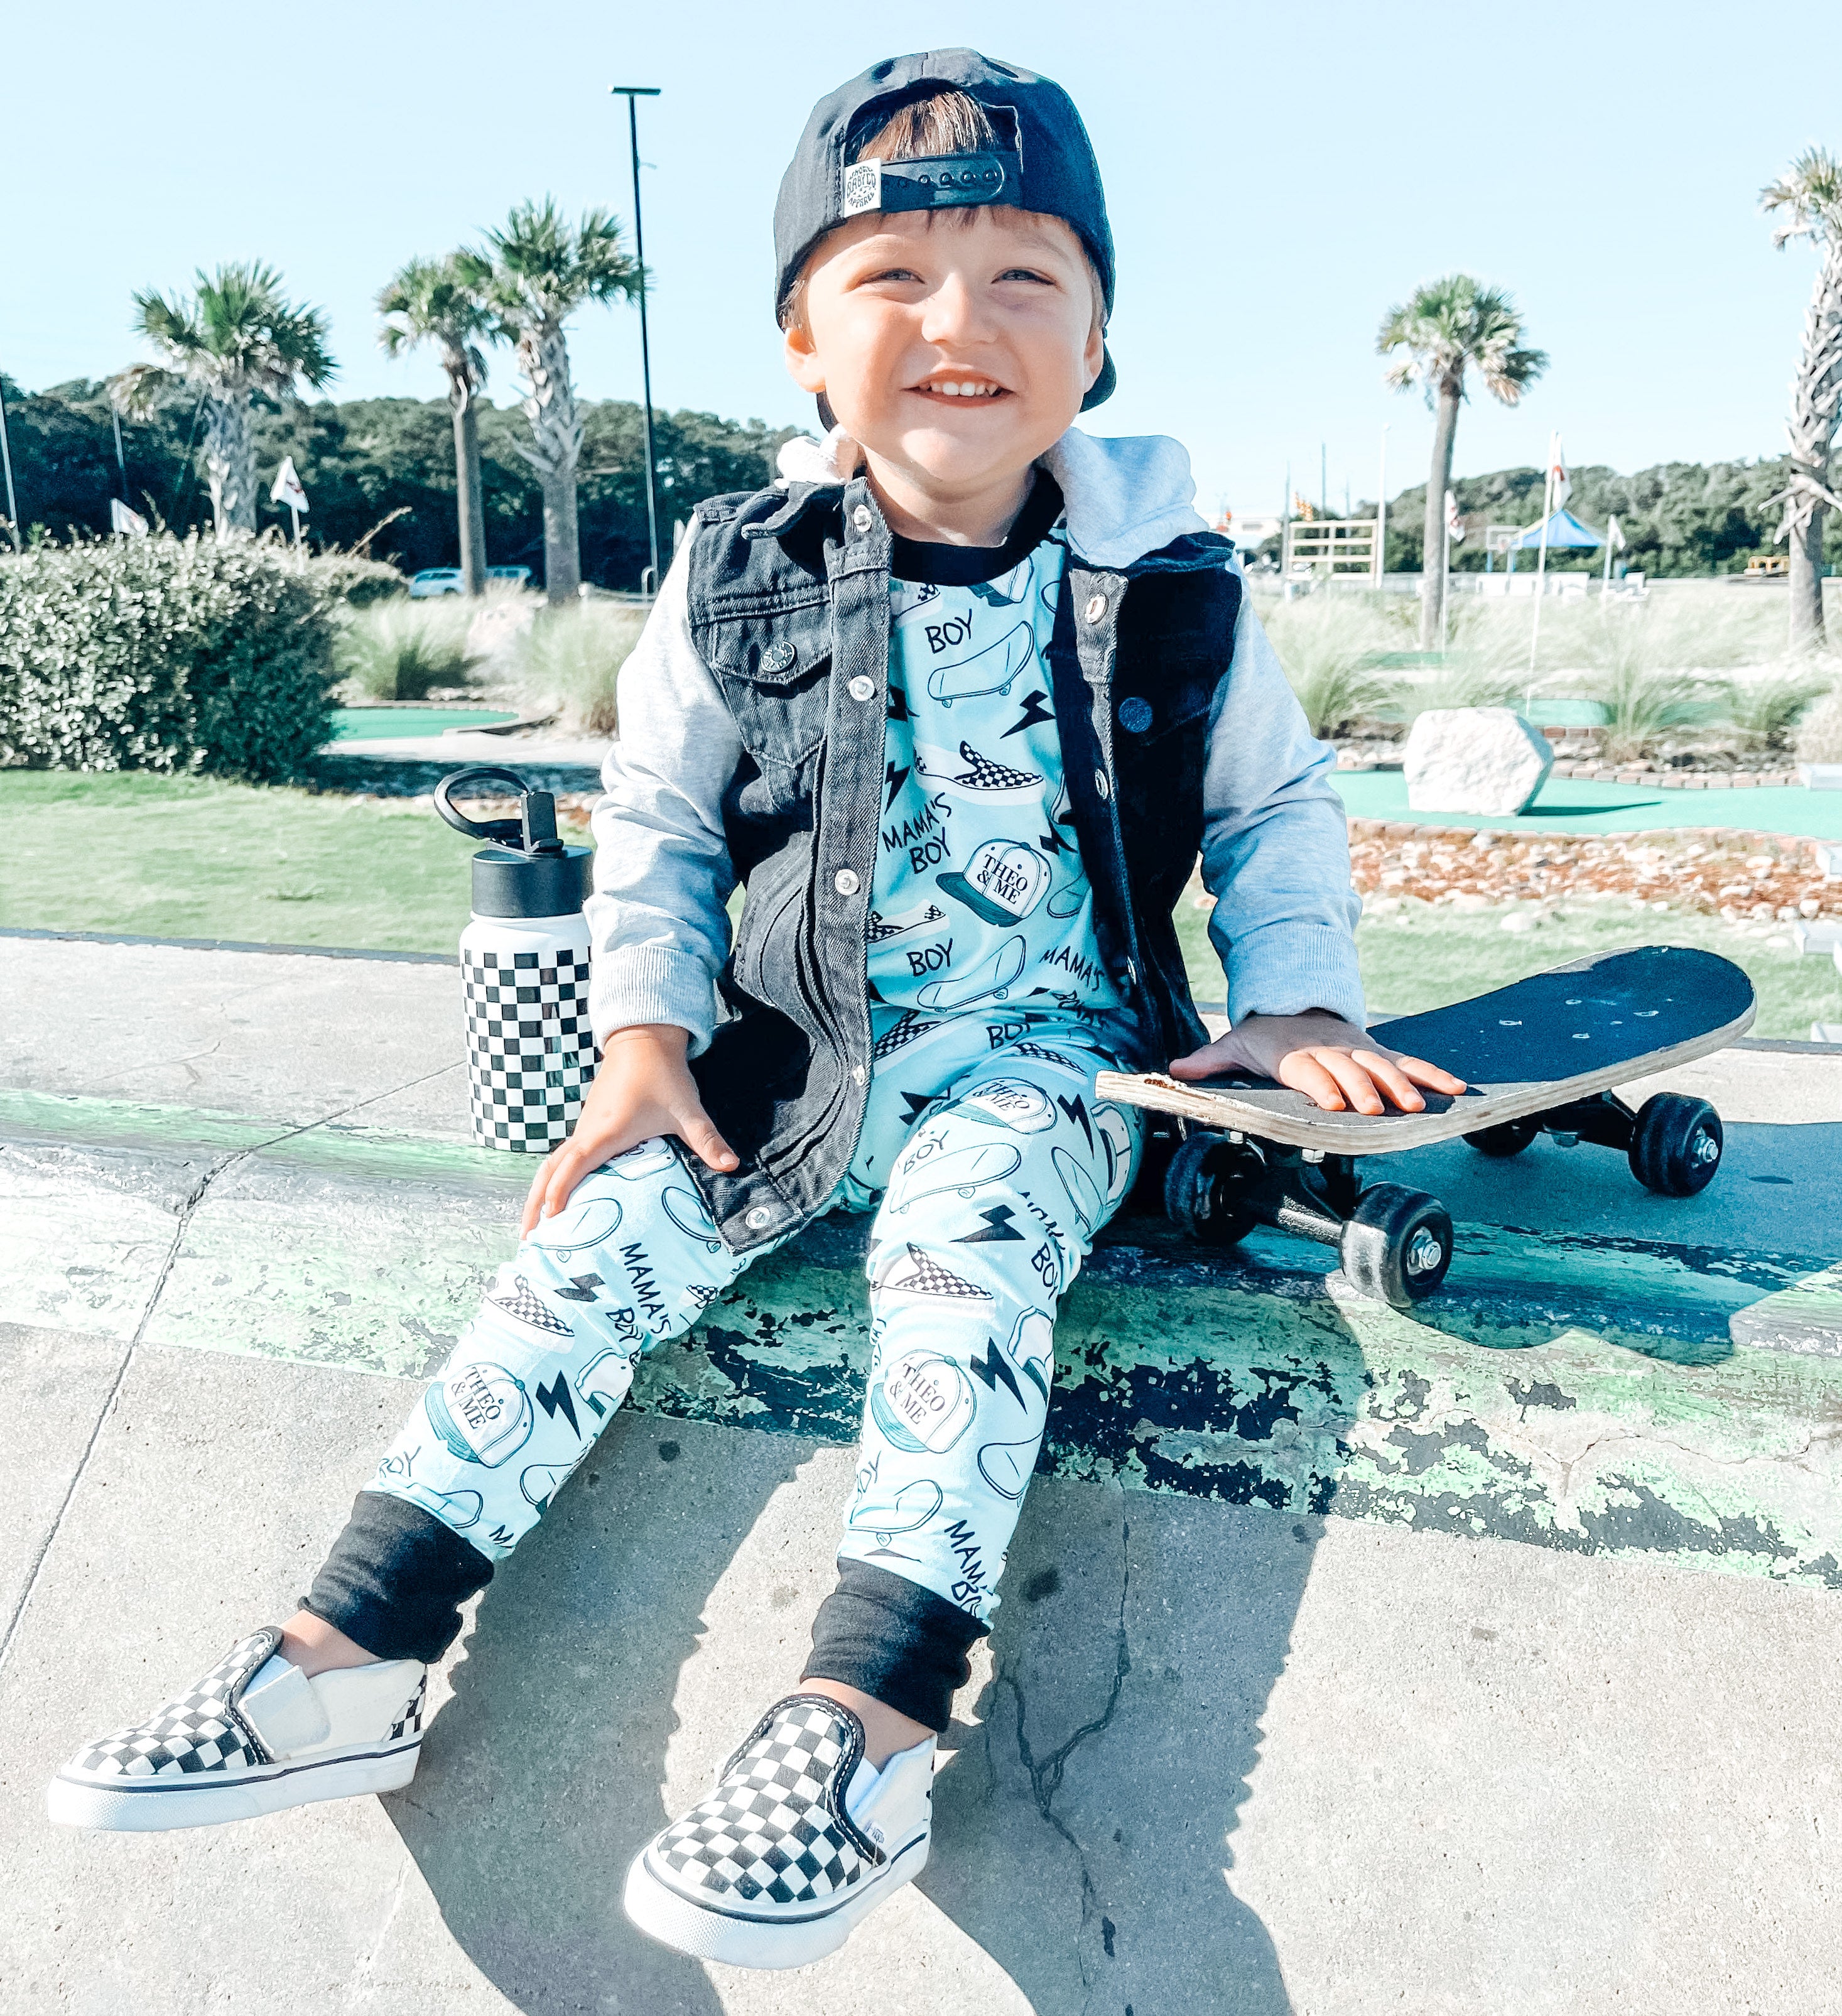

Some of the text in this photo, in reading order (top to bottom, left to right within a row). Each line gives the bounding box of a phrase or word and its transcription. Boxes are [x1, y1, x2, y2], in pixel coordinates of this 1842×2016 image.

[925, 609, 972, 654] BOY
[882, 792, 952, 852] MAMA'S
[911, 826, 951, 874] BOY
[977, 870, 1021, 905] & ME
[984, 854, 1028, 892] THEO
[906, 938, 953, 977] BOY
[1039, 945, 1105, 991] MAMA'S
[986, 1093, 1016, 1111] ME
[987, 1081, 1030, 1109] THEO
[904, 1130, 950, 1175] BOY
[619, 1243, 672, 1334] MAMA'S
[451, 1382, 487, 1429] & ME
[463, 1367, 502, 1421] THEO
[889, 1380, 927, 1424] & ME
[902, 1362, 946, 1411] THEO
